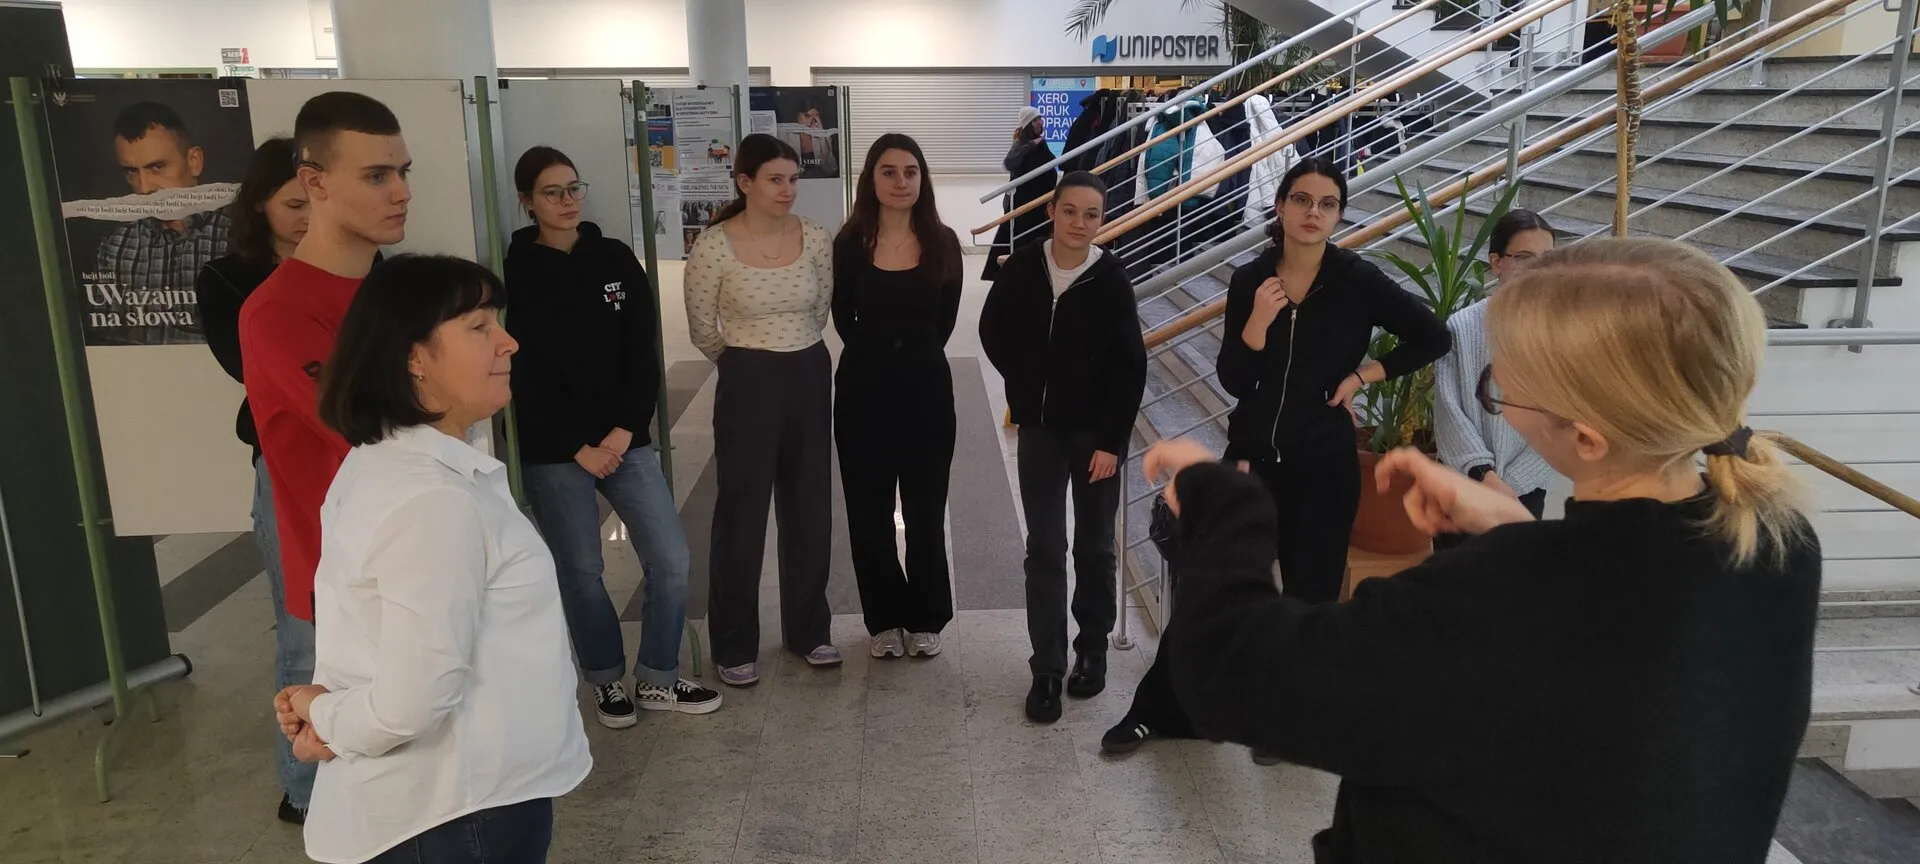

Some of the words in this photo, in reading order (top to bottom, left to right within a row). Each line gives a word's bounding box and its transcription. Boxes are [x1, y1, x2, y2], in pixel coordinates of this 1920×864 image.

[1119, 35, 1219, 58] UNIPOSTER
[1037, 93, 1069, 104] XERO
[1038, 105, 1070, 116] DRUK
[1040, 129, 1068, 140] LAK
[82, 272, 98, 280] hejt
[99, 271, 116, 280] boli
[89, 311, 122, 327] na
[125, 306, 194, 327] słowa
